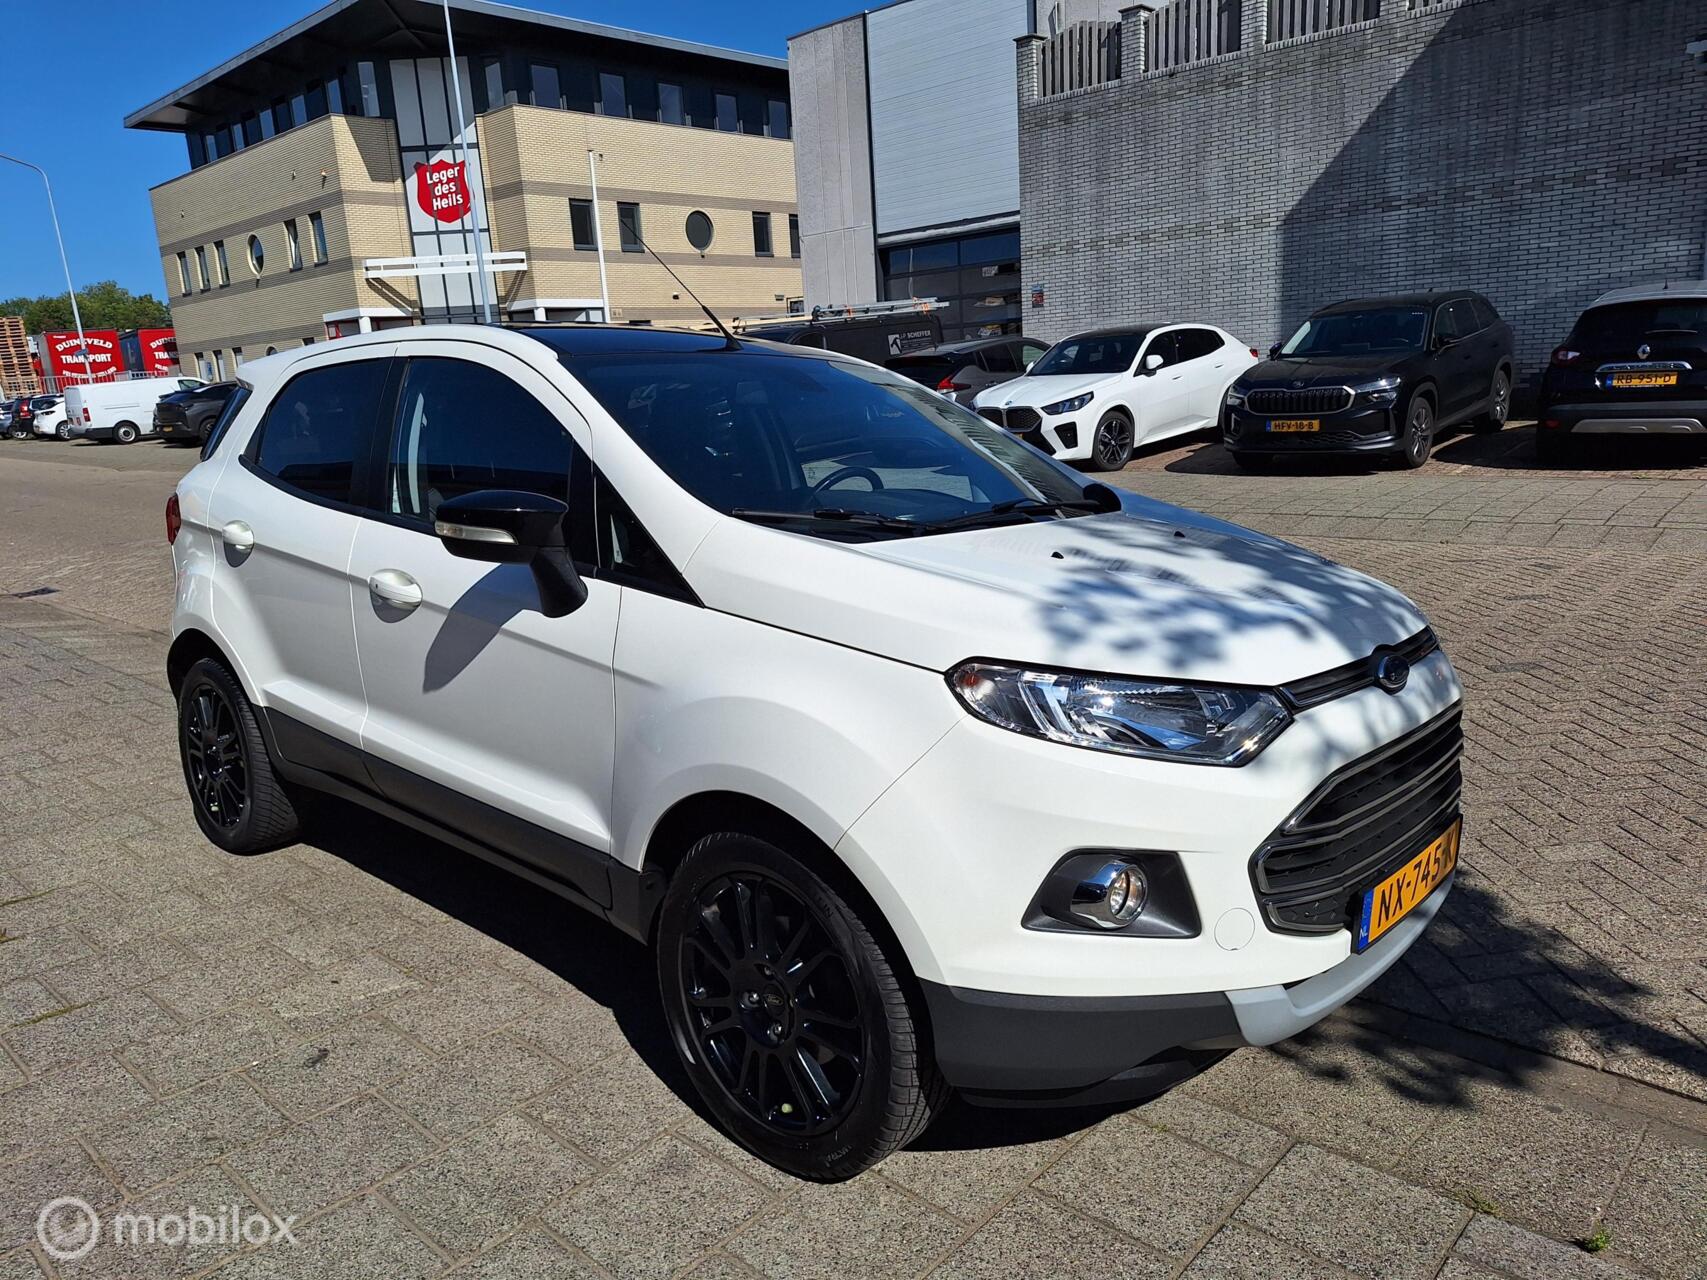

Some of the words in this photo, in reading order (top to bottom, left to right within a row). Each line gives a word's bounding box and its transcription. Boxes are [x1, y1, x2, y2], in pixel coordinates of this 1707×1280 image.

[426, 166, 460, 184] Leger
[434, 182, 456, 196] des
[432, 193, 463, 211] Heils
